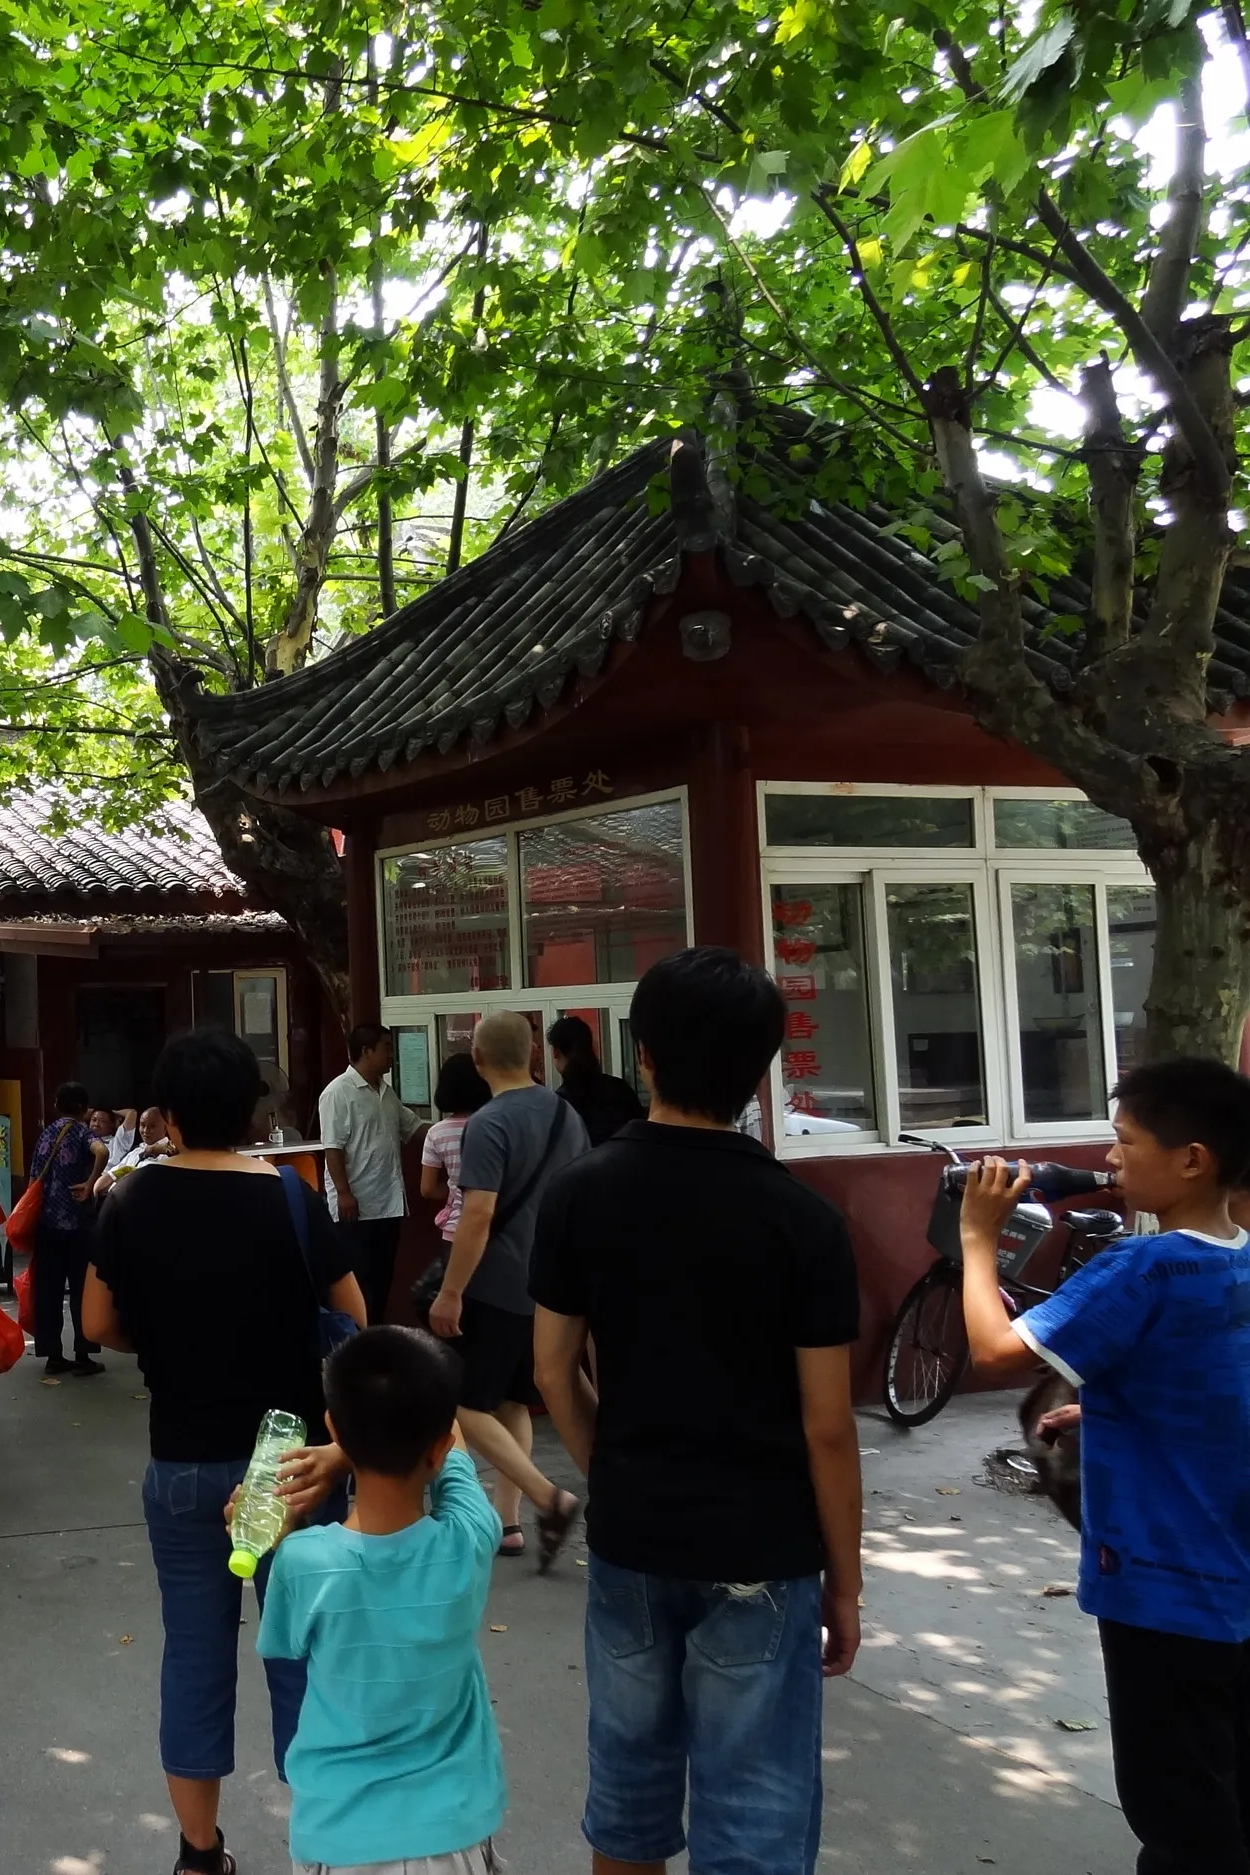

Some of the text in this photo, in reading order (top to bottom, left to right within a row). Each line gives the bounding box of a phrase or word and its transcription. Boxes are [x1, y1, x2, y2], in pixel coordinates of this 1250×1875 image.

[426, 769, 615, 832] 动物园售票处
[772, 901, 827, 1119] 动物园售票处
